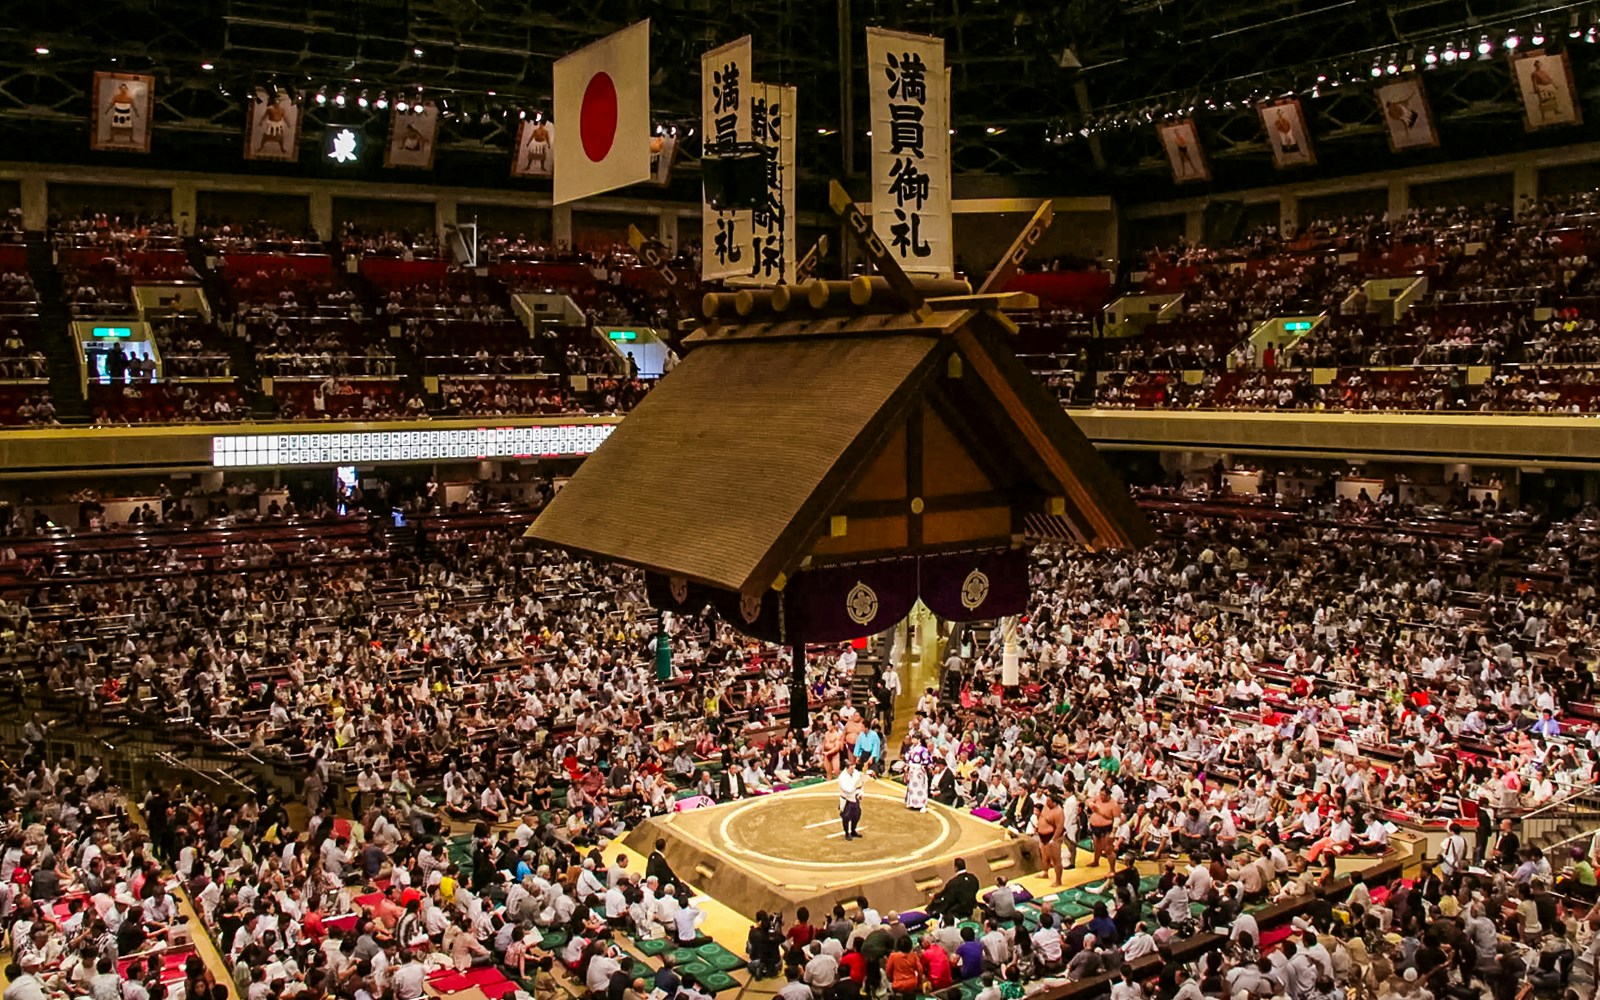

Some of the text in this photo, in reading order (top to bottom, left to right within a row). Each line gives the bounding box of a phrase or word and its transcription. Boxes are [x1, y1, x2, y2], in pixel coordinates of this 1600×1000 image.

[712, 61, 741, 265] 満員礼
[884, 52, 931, 258] 満員御礼
